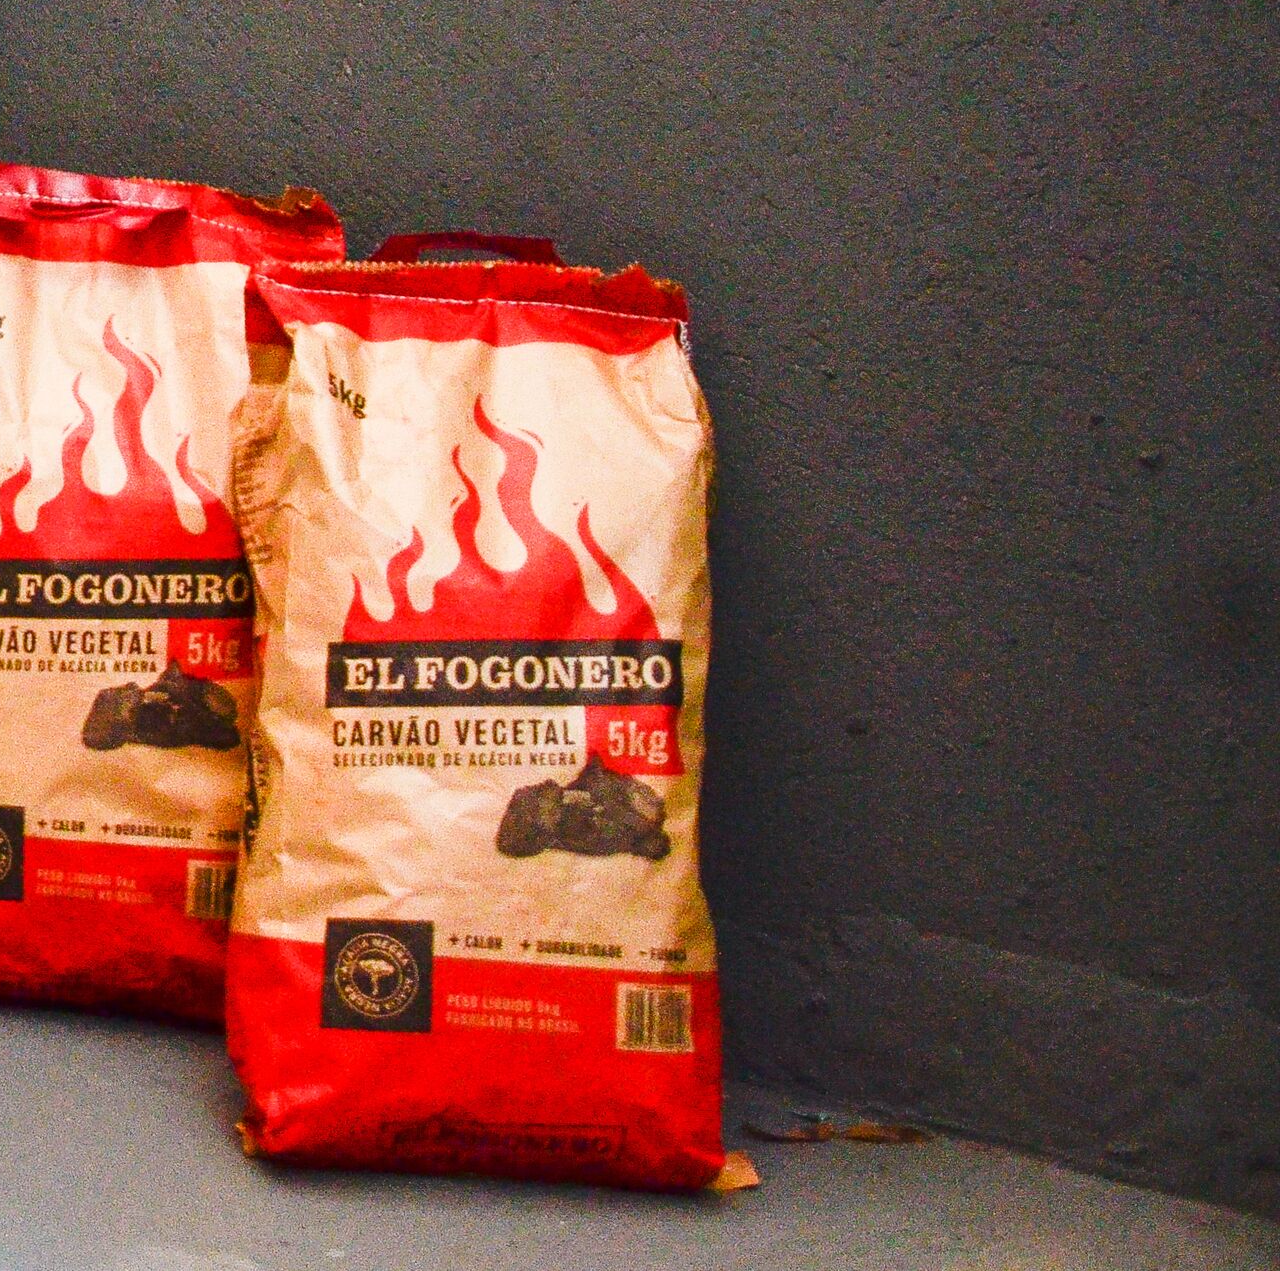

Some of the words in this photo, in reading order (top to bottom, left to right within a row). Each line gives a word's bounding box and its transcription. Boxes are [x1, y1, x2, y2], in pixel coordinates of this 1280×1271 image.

[328, 372, 366, 419] 5kg
[16, 573, 249, 606] FOGONERO
[48, 630, 157, 656] VEGETAL
[188, 632, 240, 671] 5kg
[38, 659, 54, 673] DE
[344, 657, 404, 690] EL
[415, 655, 672, 690] FOGONERO
[333, 716, 440, 747] CARVÃO
[455, 719, 576, 746] VEGETAL
[608, 720, 668, 764] 5kg
[333, 752, 436, 767] SELECIONADO
[443, 752, 460, 767] DE
[529, 751, 576, 767] NEGRA
